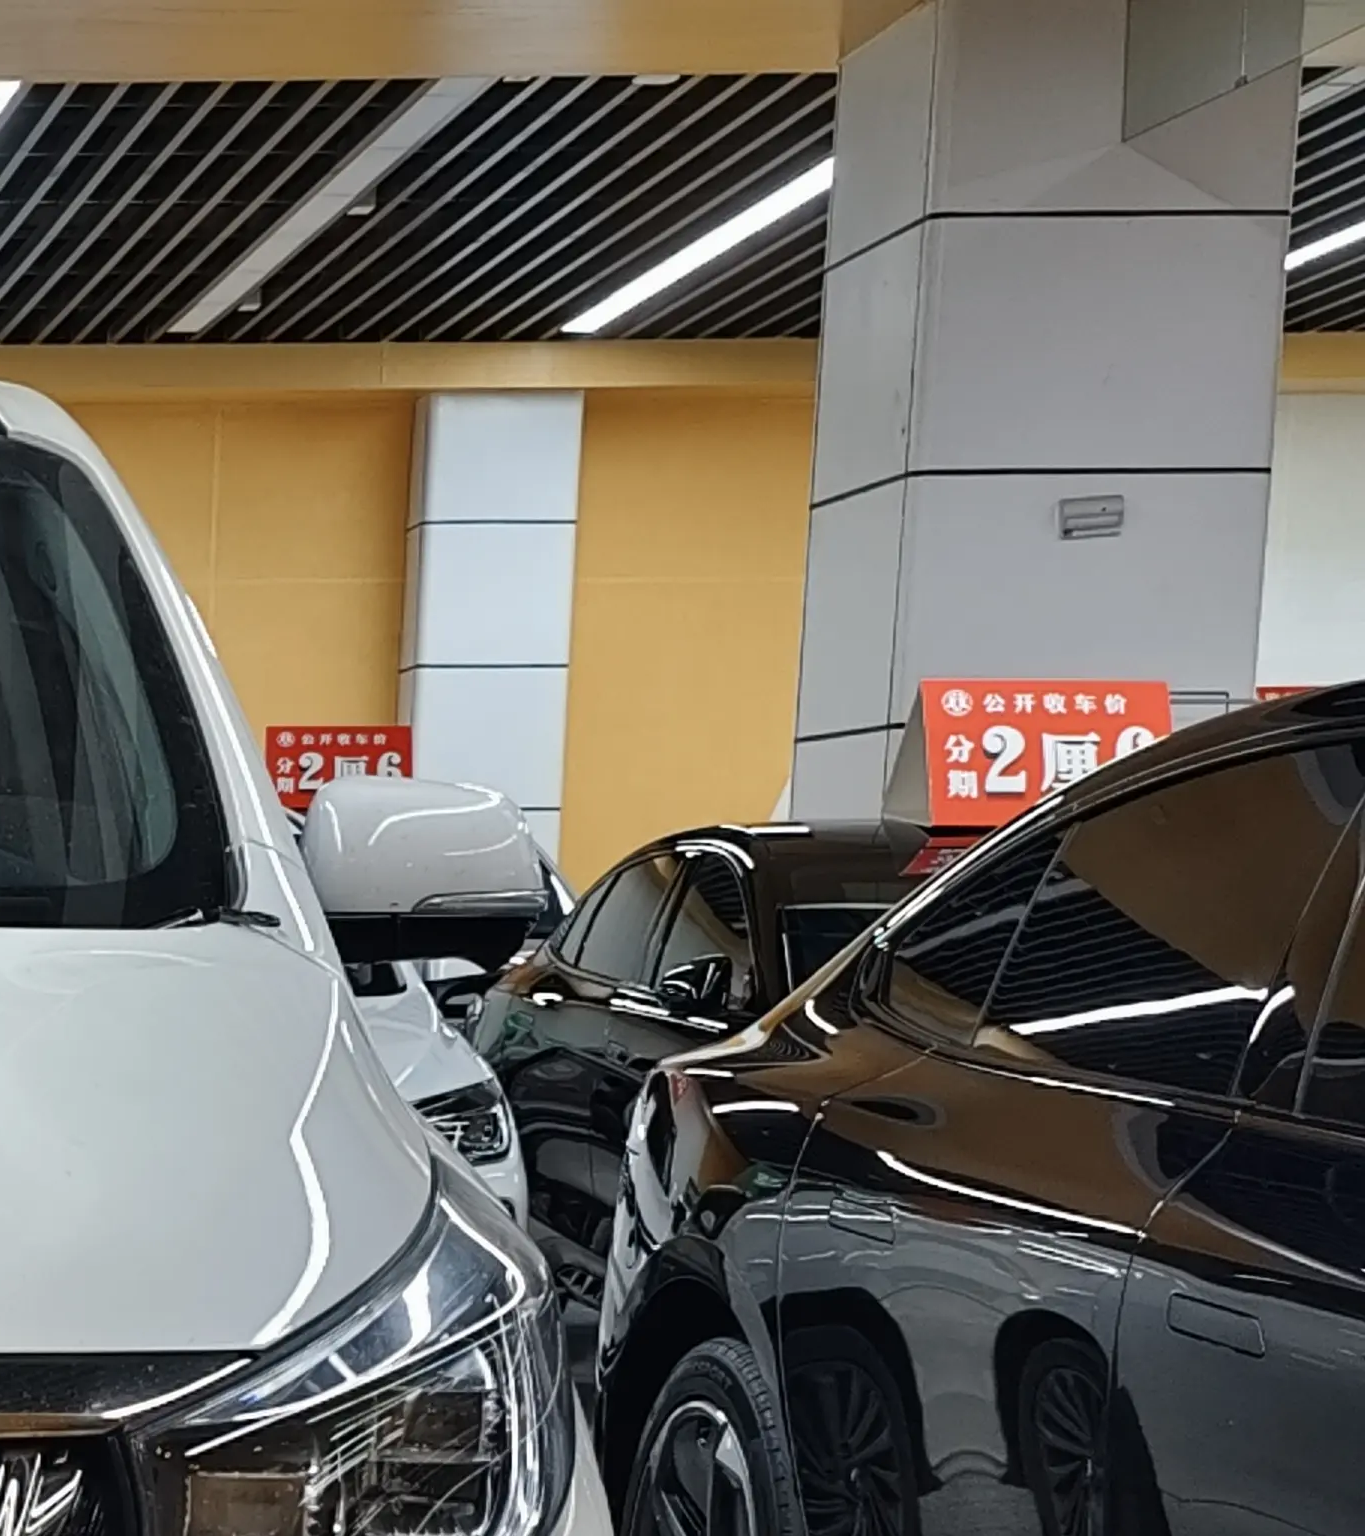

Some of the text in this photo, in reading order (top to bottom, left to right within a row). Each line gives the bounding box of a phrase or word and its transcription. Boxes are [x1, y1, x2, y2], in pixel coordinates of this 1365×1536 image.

[983, 692, 1128, 715] 公开收车价
[301, 733, 387, 746] 公开收车价
[944, 734, 979, 799] 分期
